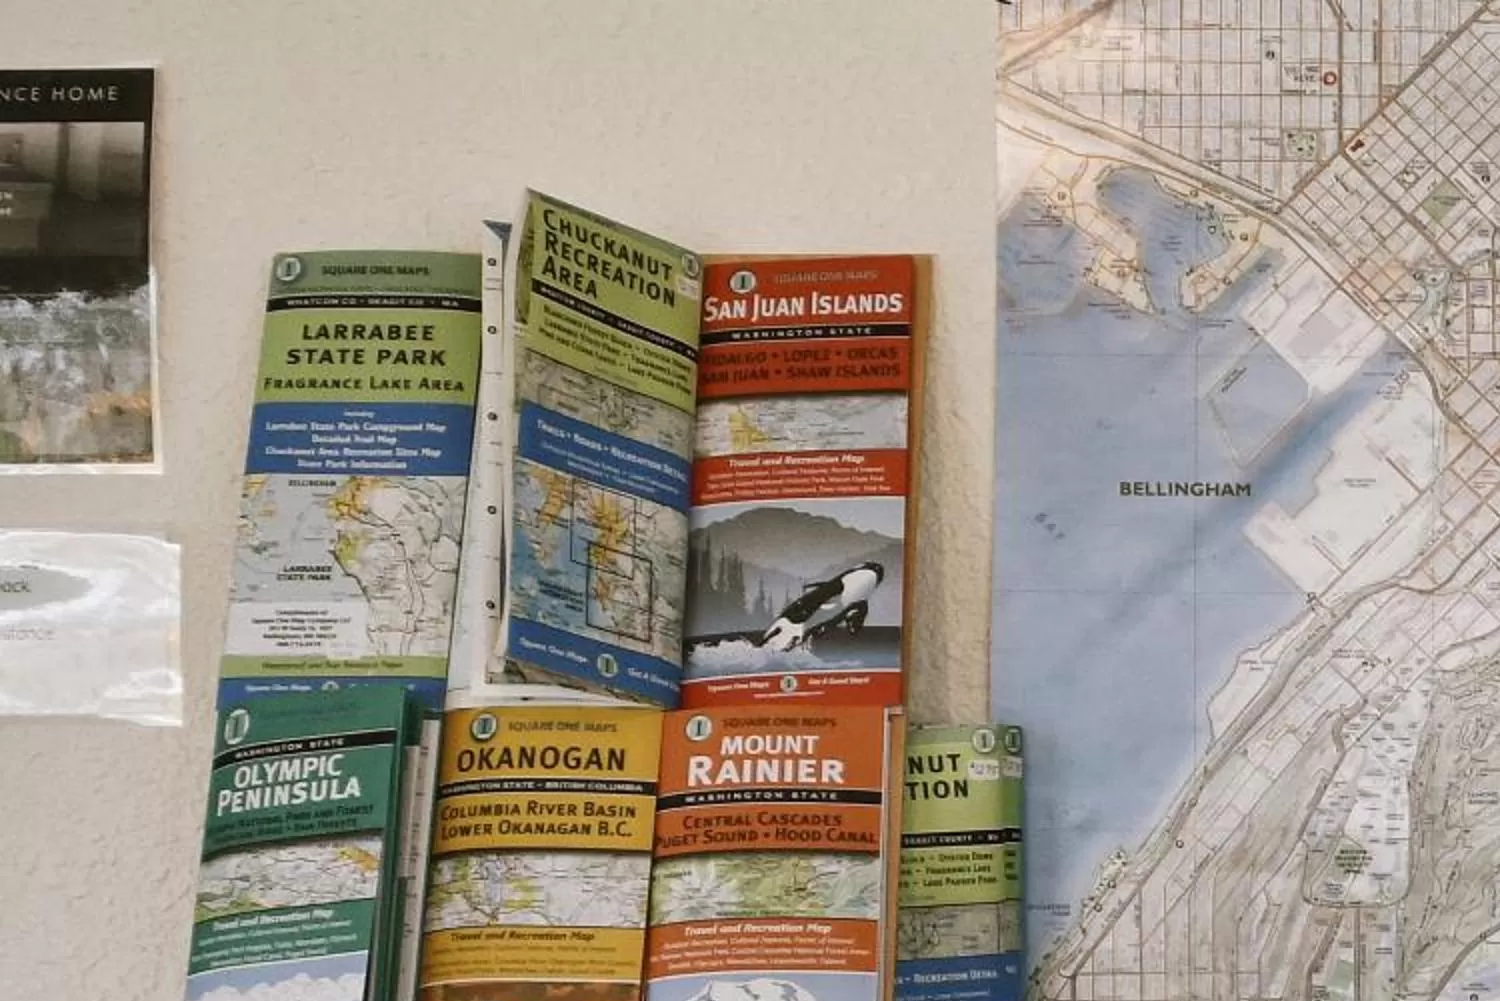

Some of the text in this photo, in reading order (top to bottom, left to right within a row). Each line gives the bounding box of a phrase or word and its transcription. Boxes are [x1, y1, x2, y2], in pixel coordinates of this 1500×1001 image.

[52, 85, 118, 101] HOME
[543, 209, 672, 280] CHUCKANUT
[322, 265, 429, 277] SQUARE ONE MAPS
[542, 256, 598, 299] AREA
[545, 232, 675, 308] RECREATION
[704, 291, 903, 322] SAN JUAN ISLANDS
[302, 324, 435, 341] LARRABEE
[732, 327, 872, 339] WASHINGTON STATE
[286, 349, 446, 366] STATE PARK
[784, 348, 830, 362] LOPEZ
[734, 363, 899, 382] JUAN SHAW ISLANDS
[263, 376, 464, 392] FRAGRANCE LAKE AREA
[1119, 480, 1253, 498] BELLINGHAM
[235, 738, 344, 759] WASHINGTON STATE
[720, 735, 820, 756] MOUNT
[457, 746, 626, 772] OKANOGAN
[907, 754, 961, 775] NUT
[234, 754, 344, 789] OLYMPIC
[688, 755, 845, 787] RAINIER
[217, 777, 362, 816] PENINSULA
[685, 792, 837, 803] WASHINGTON STATE
[904, 780, 968, 800] TION
[441, 800, 636, 821] COLUMBIA RIVER BASIN
[682, 811, 842, 830] CENTRAL CASCADES
[441, 820, 633, 840] LOWER OKANAGAN B.C.
[655, 827, 878, 849] PUGET SOUND HOOD CANAL
[685, 924, 831, 937] Travel and Recreation Map
